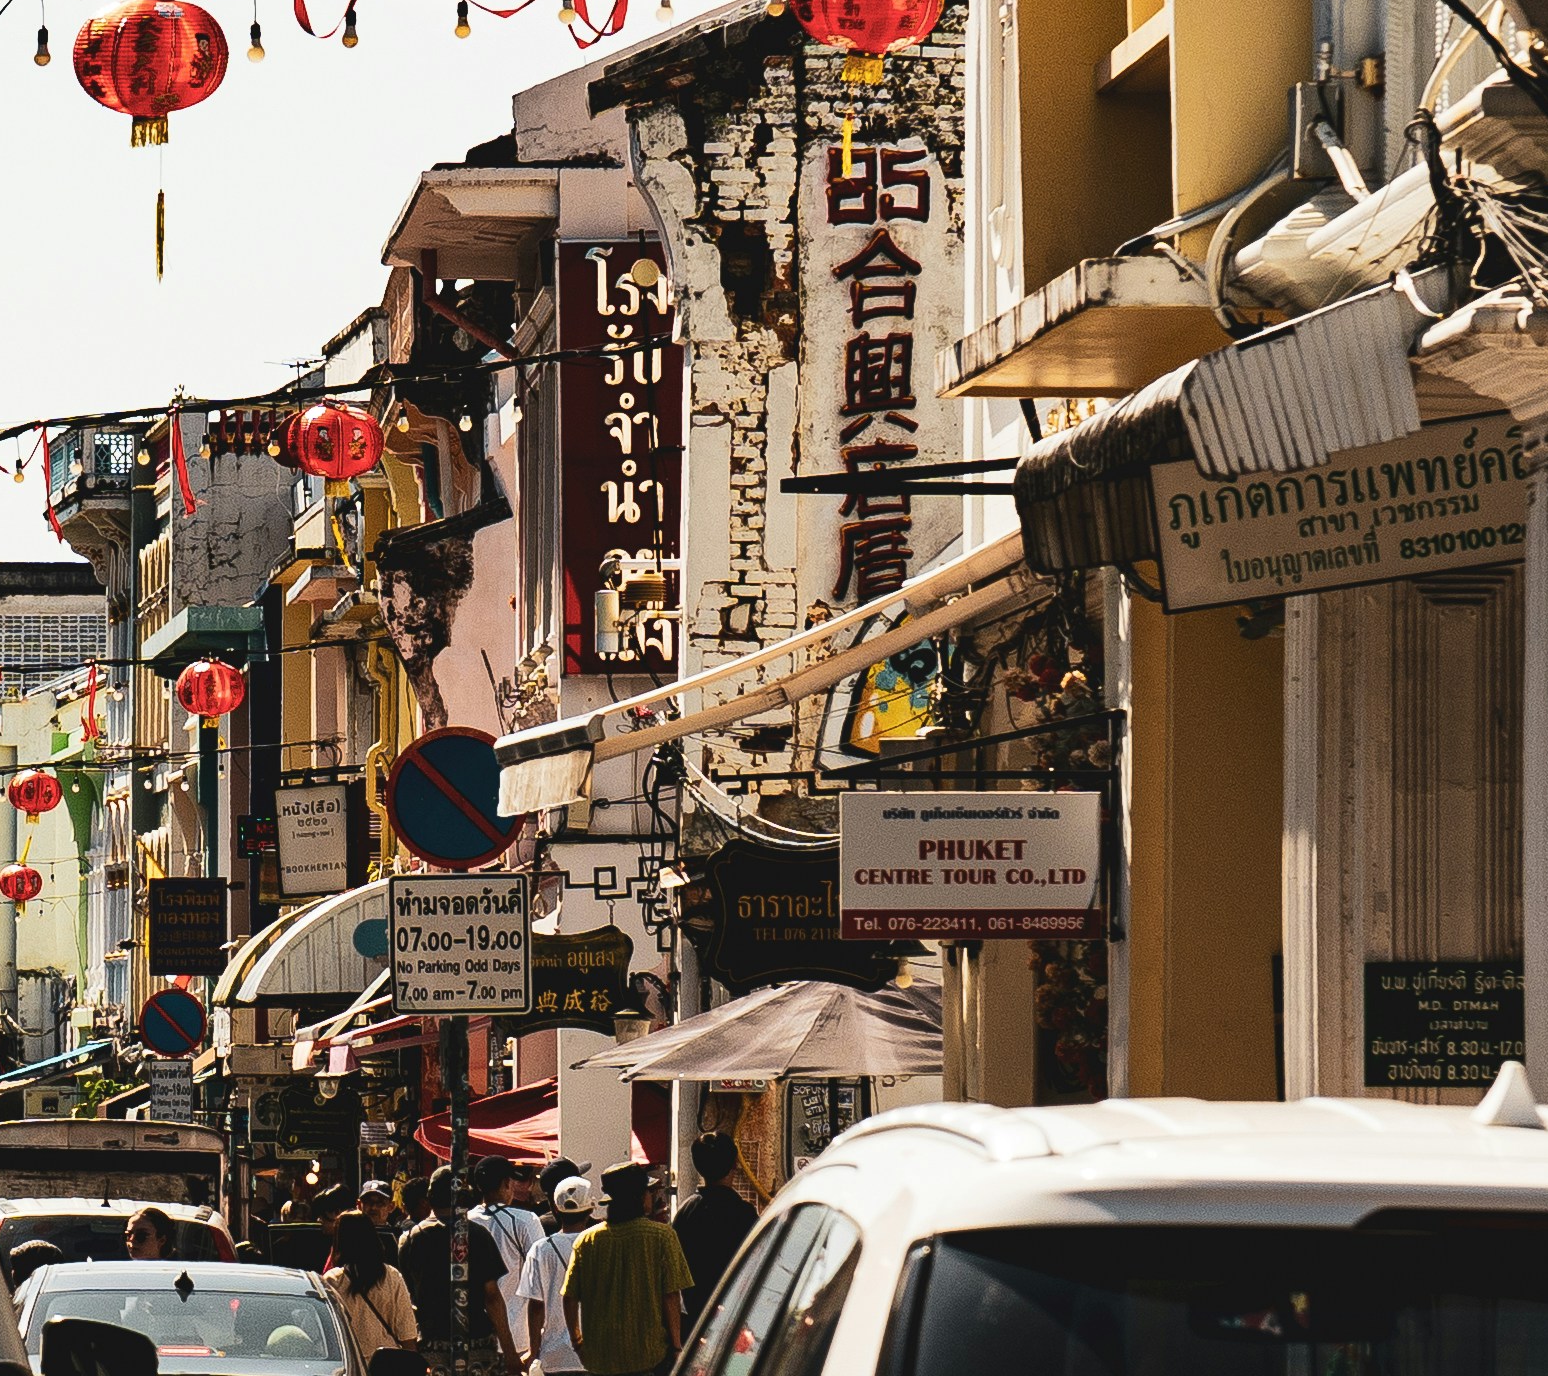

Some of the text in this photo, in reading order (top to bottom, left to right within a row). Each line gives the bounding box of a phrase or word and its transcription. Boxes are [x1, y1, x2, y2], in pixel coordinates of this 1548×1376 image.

[826, 147, 930, 224] 85
[1297, 493, 1480, 538] สาขา เวชกรรม
[1222, 522, 1528, 586] ใบอนุญาตเลขที่ 831010012
[882, 807, 916, 820] บริษัท
[1028, 808, 1060, 820] จำกัด
[918, 839, 1029, 861] PHUKET
[285, 862, 347, 874] BOOKHEMIAN
[854, 868, 1087, 888] CENTRE TOUR CO.,LTD
[156, 888, 220, 906] โรงพิมพ์
[396, 880, 522, 916] ห้ามจอดวันคี่
[158, 911, 219, 924] กองทอง
[854, 917, 883, 931] Tel.
[888, 917, 983, 932] 076-223411,
[396, 925, 522, 952] 07.00-19.00
[811, 927, 840, 941] 2118
[397, 958, 521, 976] No Parking Odd Days
[567, 945, 615, 974] อยู่เสง
[398, 980, 429, 1002] 7.00
[501, 987, 523, 1002] pm
